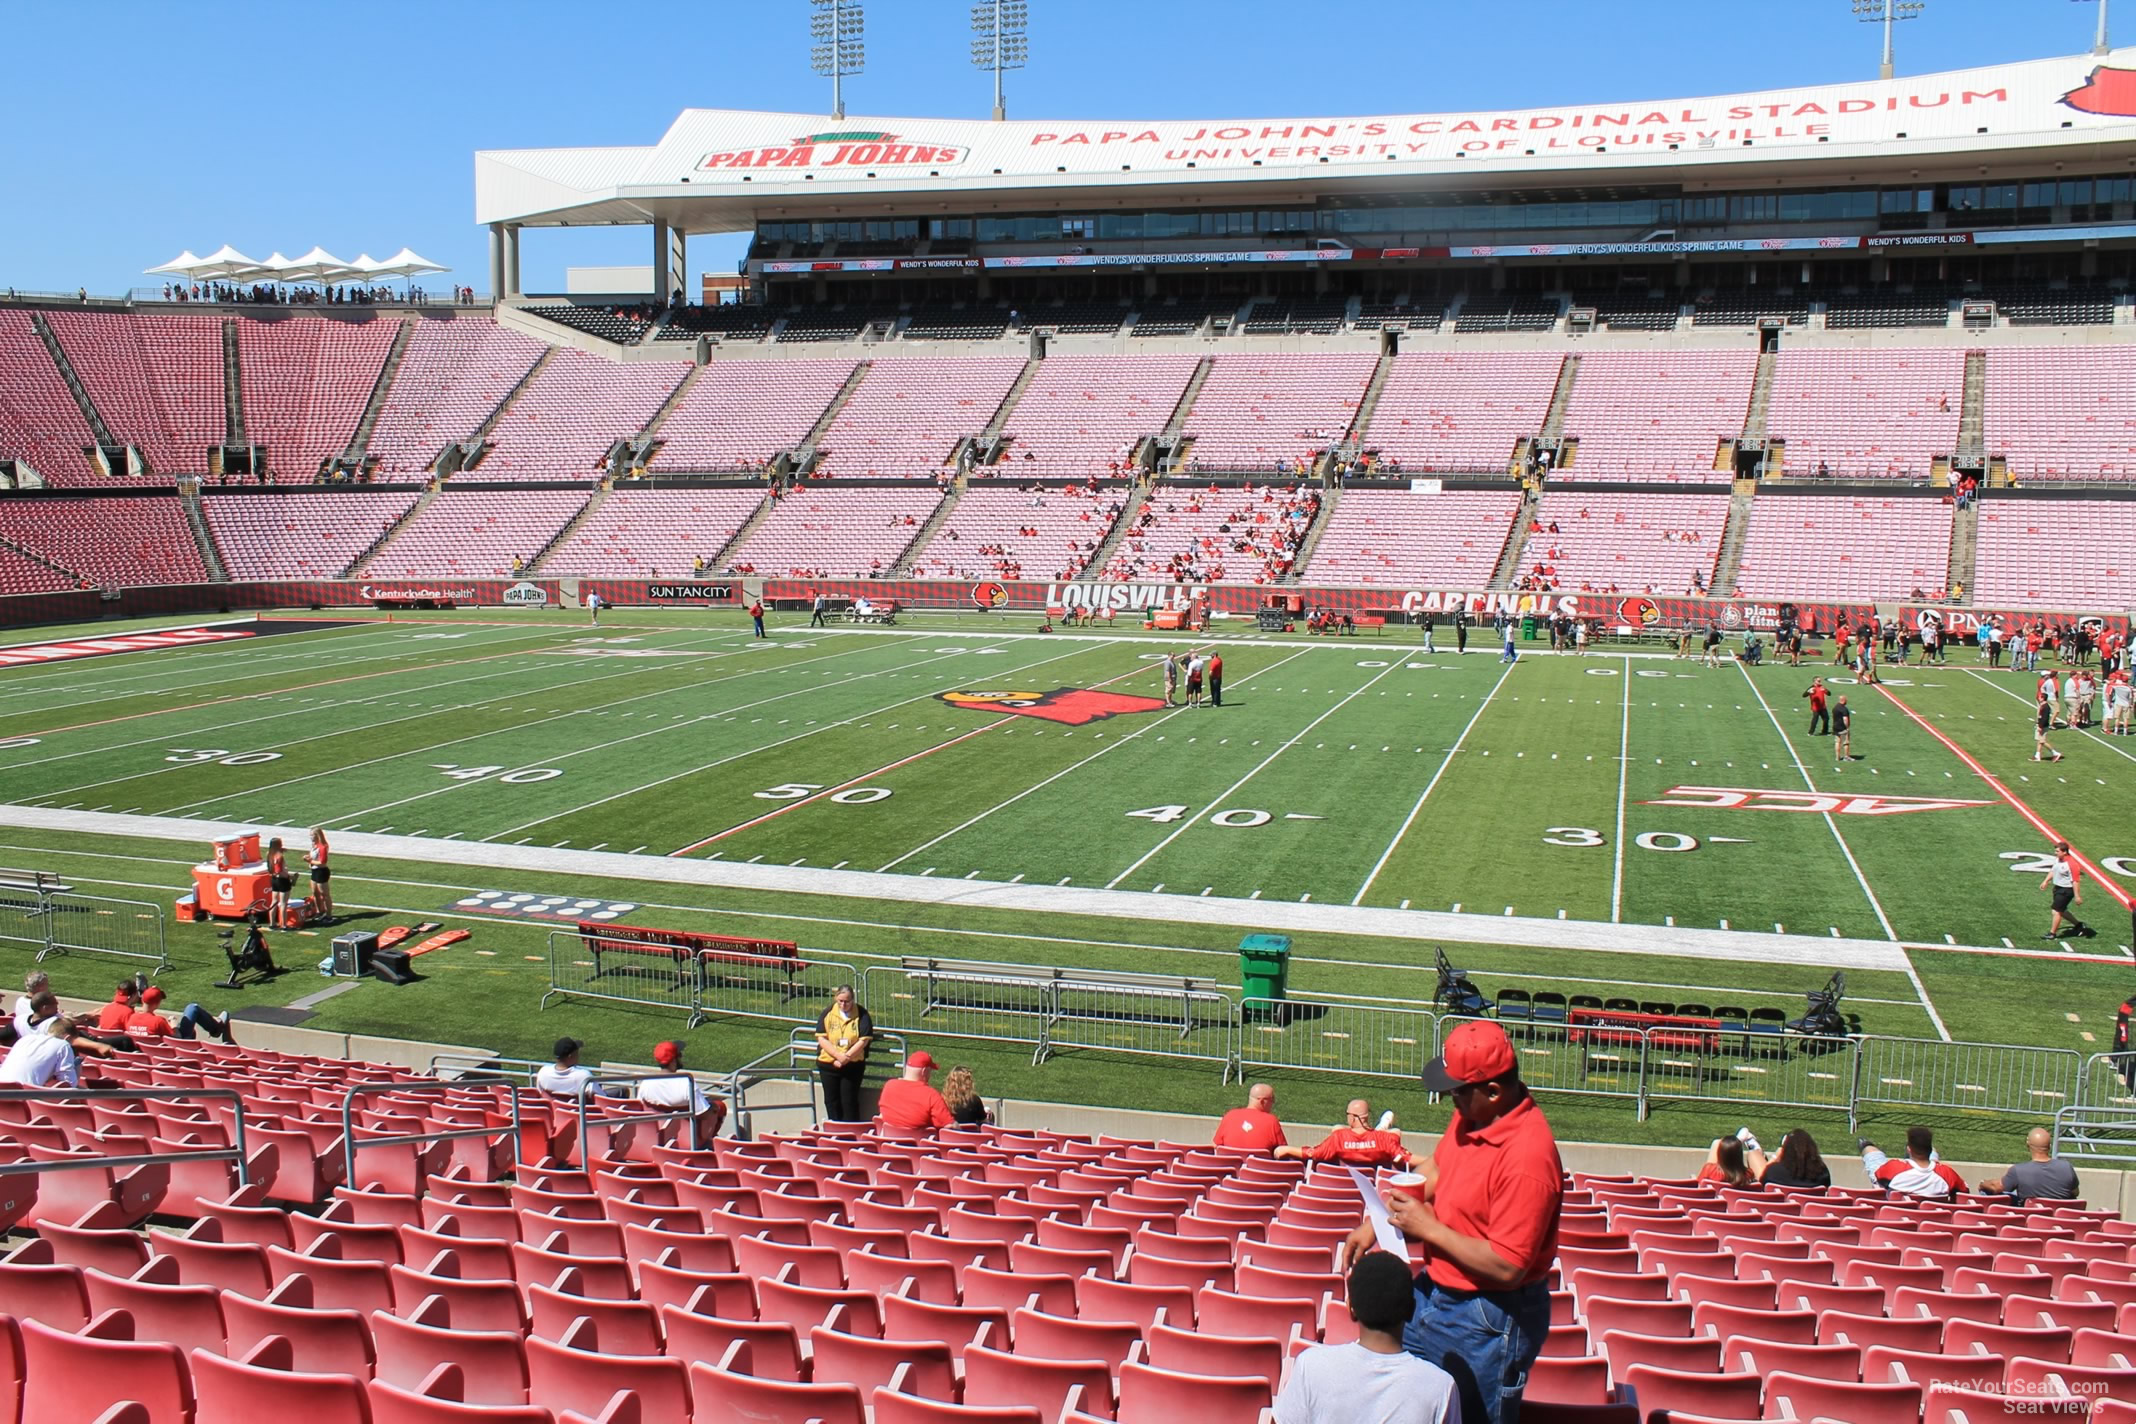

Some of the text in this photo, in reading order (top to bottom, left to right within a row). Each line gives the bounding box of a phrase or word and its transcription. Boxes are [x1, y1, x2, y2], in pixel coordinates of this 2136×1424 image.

[1030, 89, 2007, 145] PAPA JOHN'S CARDINAL STADIUM
[1163, 123, 1832, 161] UNIVERSITY OF LOUISVILLE
[704, 146, 815, 168] PAPA
[1569, 241, 1744, 254] WENDY'S WONDERFUL KIDS SPRING GAME
[1867, 235, 1967, 246] WENDY'S WONDERFUL KIDS
[900, 259, 979, 269] WENDY'S WONDERFUL KIDS
[1093, 252, 1249, 265] WENDY'S WONDERFUL KIDS SPRING GAME
[505, 589, 523, 601] PAPA
[651, 586, 731, 598] SUN TAN CITY
[165, 748, 284, 766] 30
[440, 765, 563, 783] 40
[752, 782, 894, 805] 50
[1124, 804, 1272, 828] 40
[1542, 827, 1700, 852] 30
[216, 878, 234, 900] G
[1344, 1141, 1376, 1149] CARDINALS
